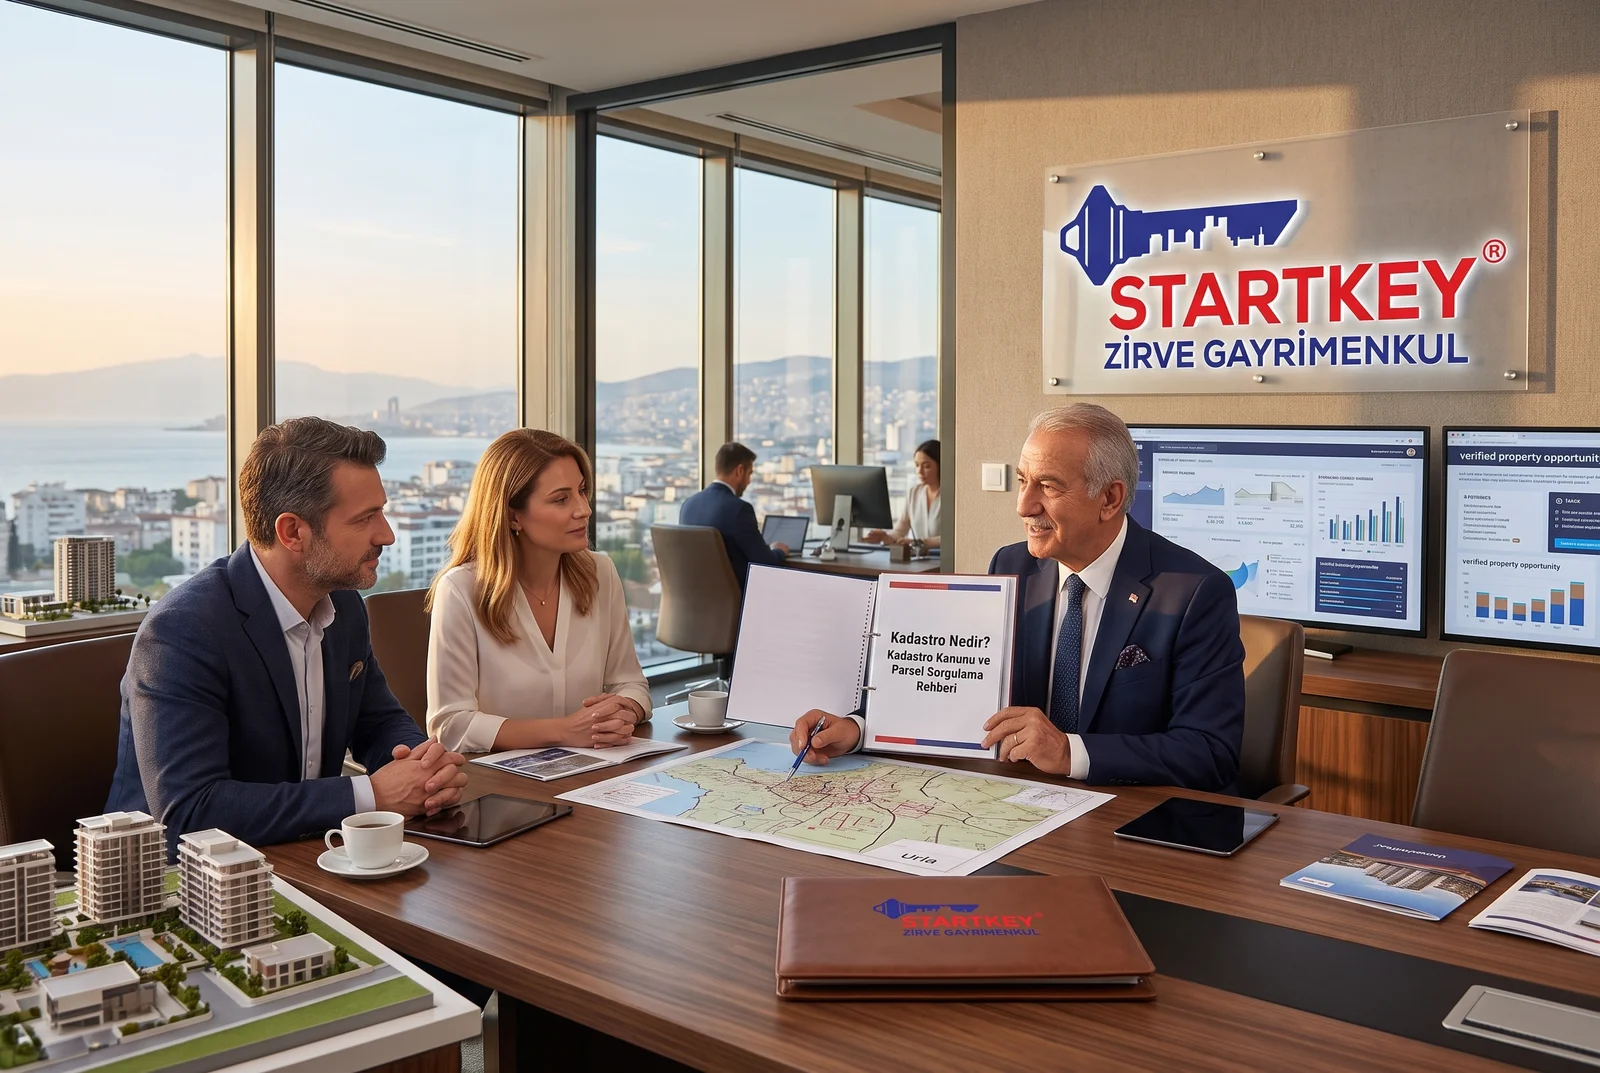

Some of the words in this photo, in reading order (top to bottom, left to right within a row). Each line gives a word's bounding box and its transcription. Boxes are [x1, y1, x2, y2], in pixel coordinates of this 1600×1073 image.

[1109, 257, 1477, 331] STARTKEY
[1104, 335, 1195, 370] ZİRVE
[1203, 329, 1469, 368] GAYRİMENKUL
[1460, 451, 1496, 461] verified
[1498, 453, 1541, 463] property
[1544, 453, 1600, 464] opportunit
[1462, 558, 1488, 566] verified
[1489, 560, 1518, 569] property
[1519, 562, 1561, 571] opportunity
[890, 631, 946, 647] Kadastro
[949, 635, 991, 649] Nedir?
[887, 649, 934, 663] Kadastro
[936, 652, 976, 665] Kanunu
[978, 656, 991, 665] ve
[891, 665, 925, 677] Parsel
[926, 667, 984, 680] Sorgulama
[916, 681, 957, 693] Rehberi
[901, 915, 1034, 928] STARTKEY
